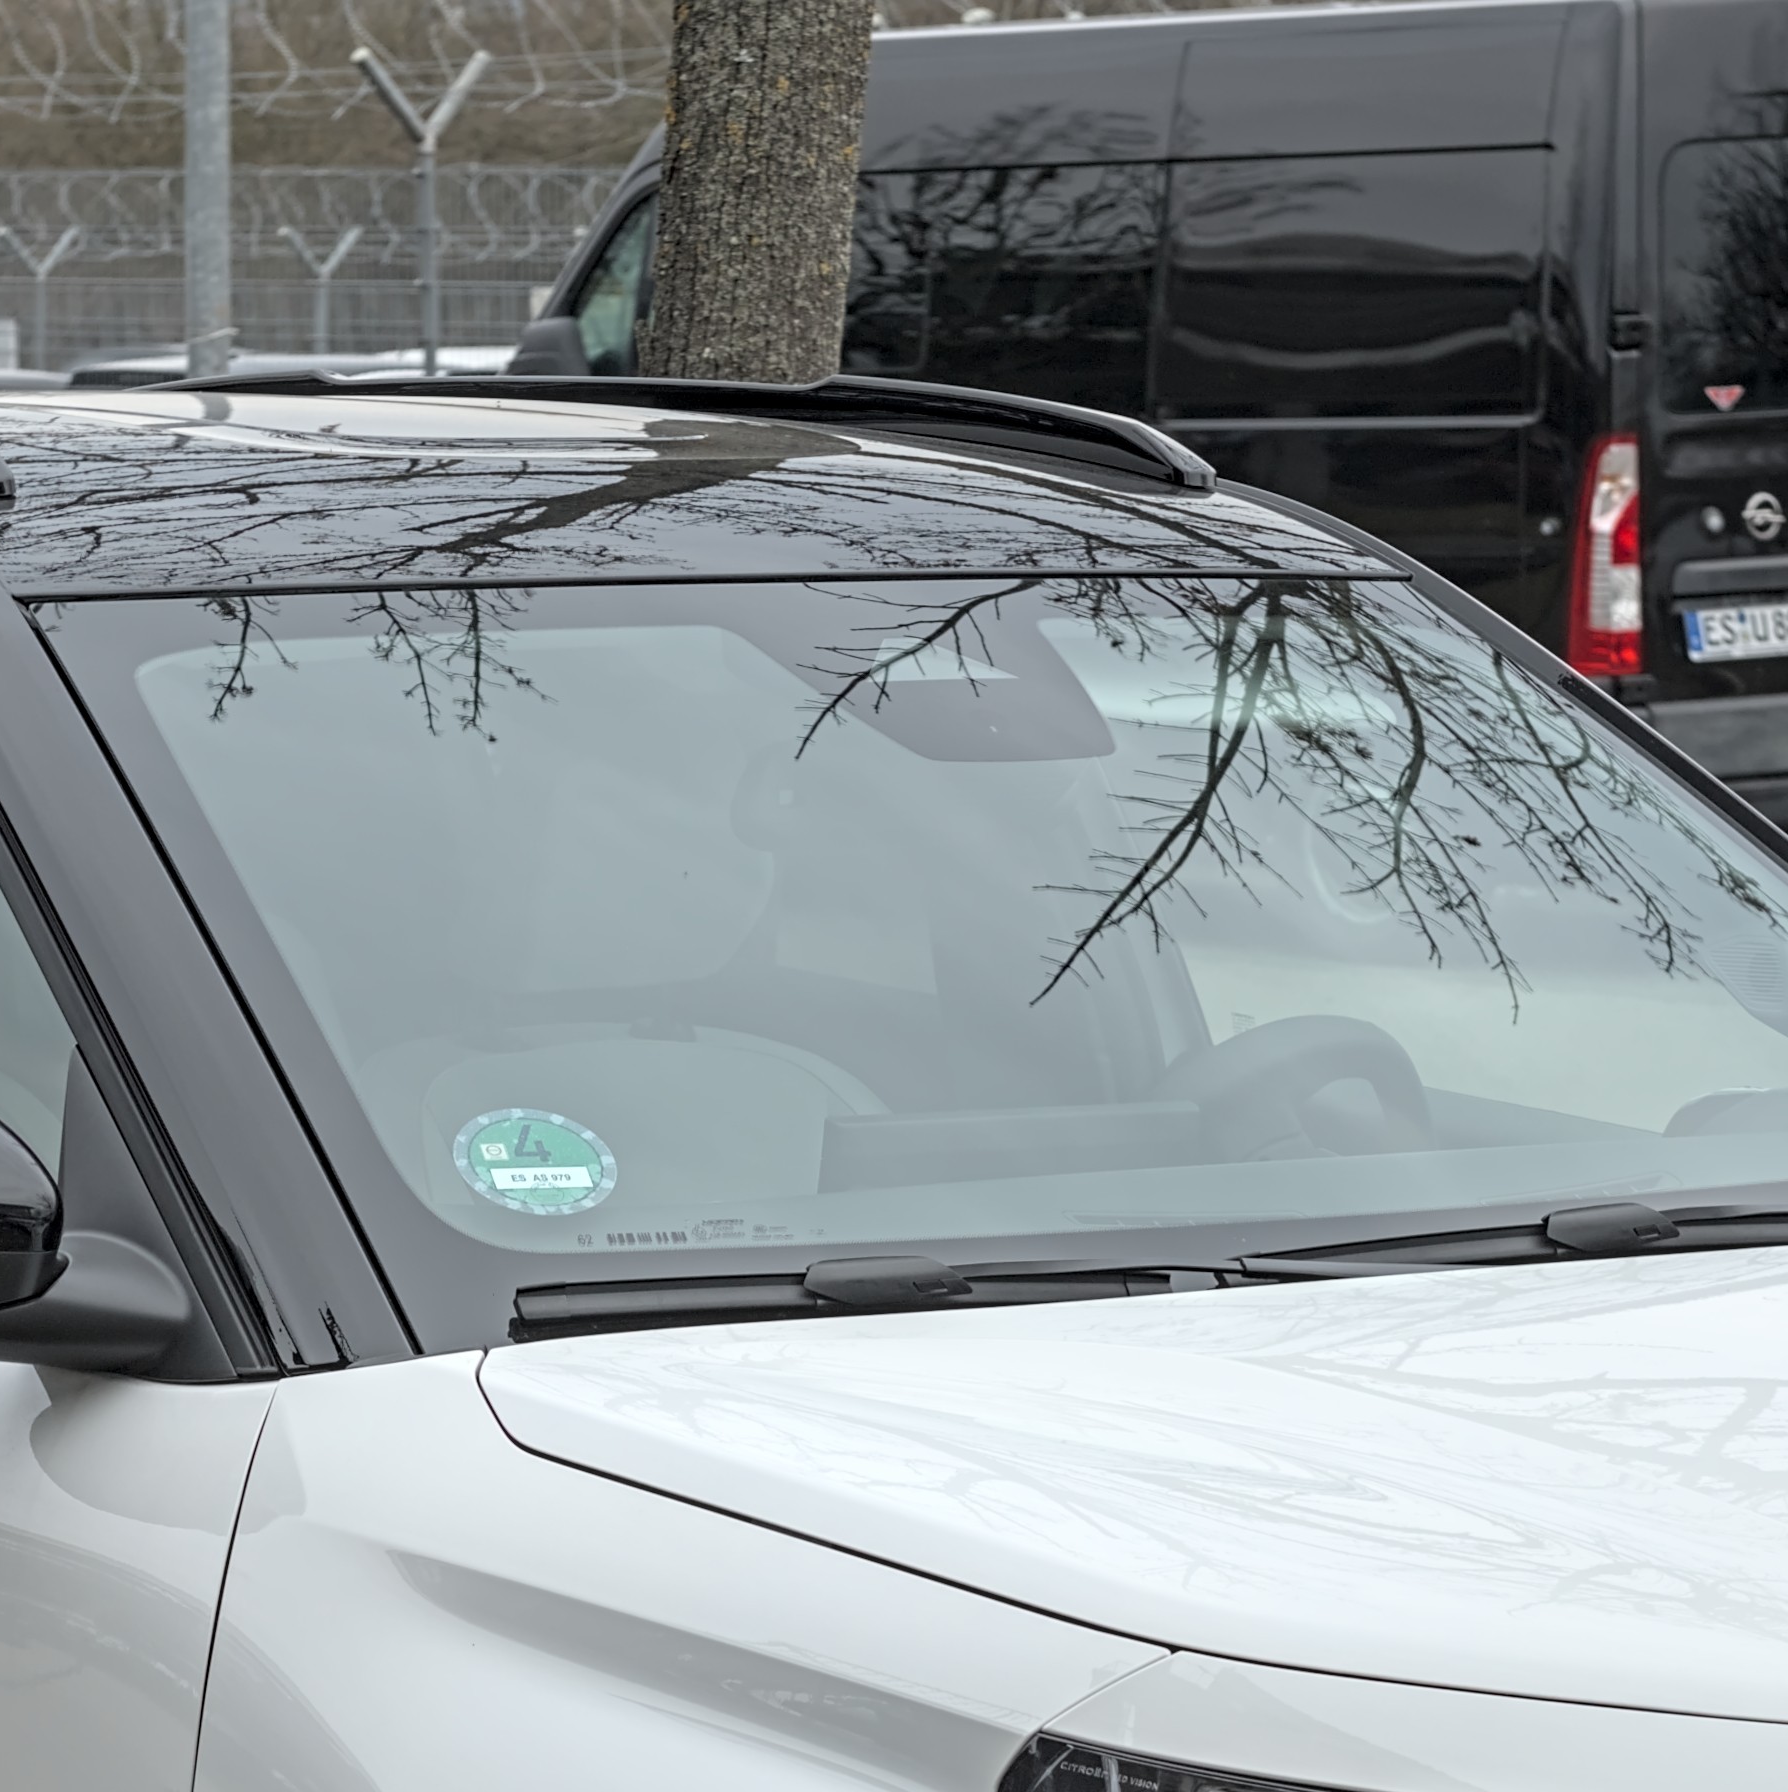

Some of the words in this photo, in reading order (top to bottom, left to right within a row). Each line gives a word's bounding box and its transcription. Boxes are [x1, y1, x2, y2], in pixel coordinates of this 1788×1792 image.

[1704, 614, 1736, 646] ES
[1750, 612, 1769, 641] U
[514, 1124, 552, 1162] 4
[511, 1174, 527, 1182] ES
[533, 1174, 548, 1182] AS
[550, 1173, 572, 1182] 979
